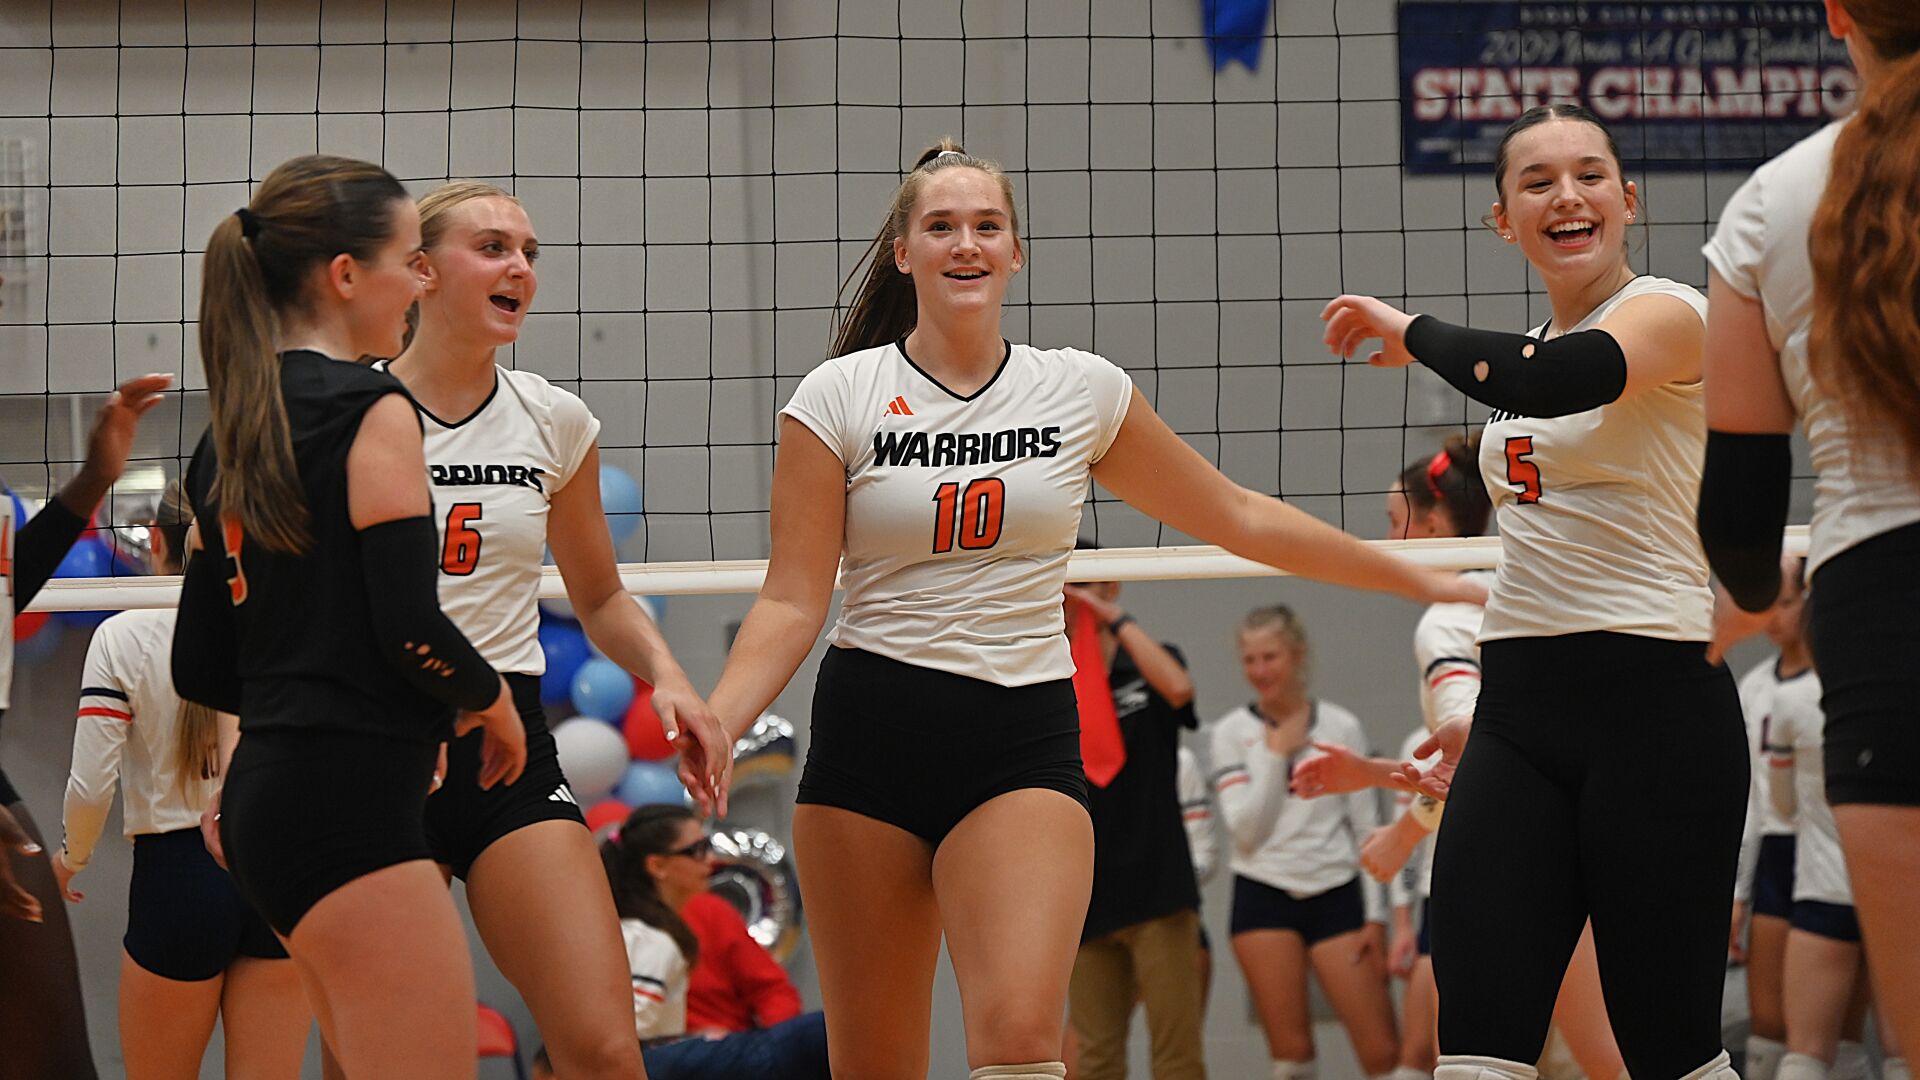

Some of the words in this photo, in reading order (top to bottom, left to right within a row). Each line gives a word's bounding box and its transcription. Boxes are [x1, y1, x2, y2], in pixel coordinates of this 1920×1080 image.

[1481, 29, 1562, 64] 2009
[1413, 66, 1583, 121] STATE
[873, 426, 1062, 467] WARRIORS
[1504, 435, 1542, 505] 5
[440, 502, 482, 576] 6
[932, 477, 1006, 554] 10
